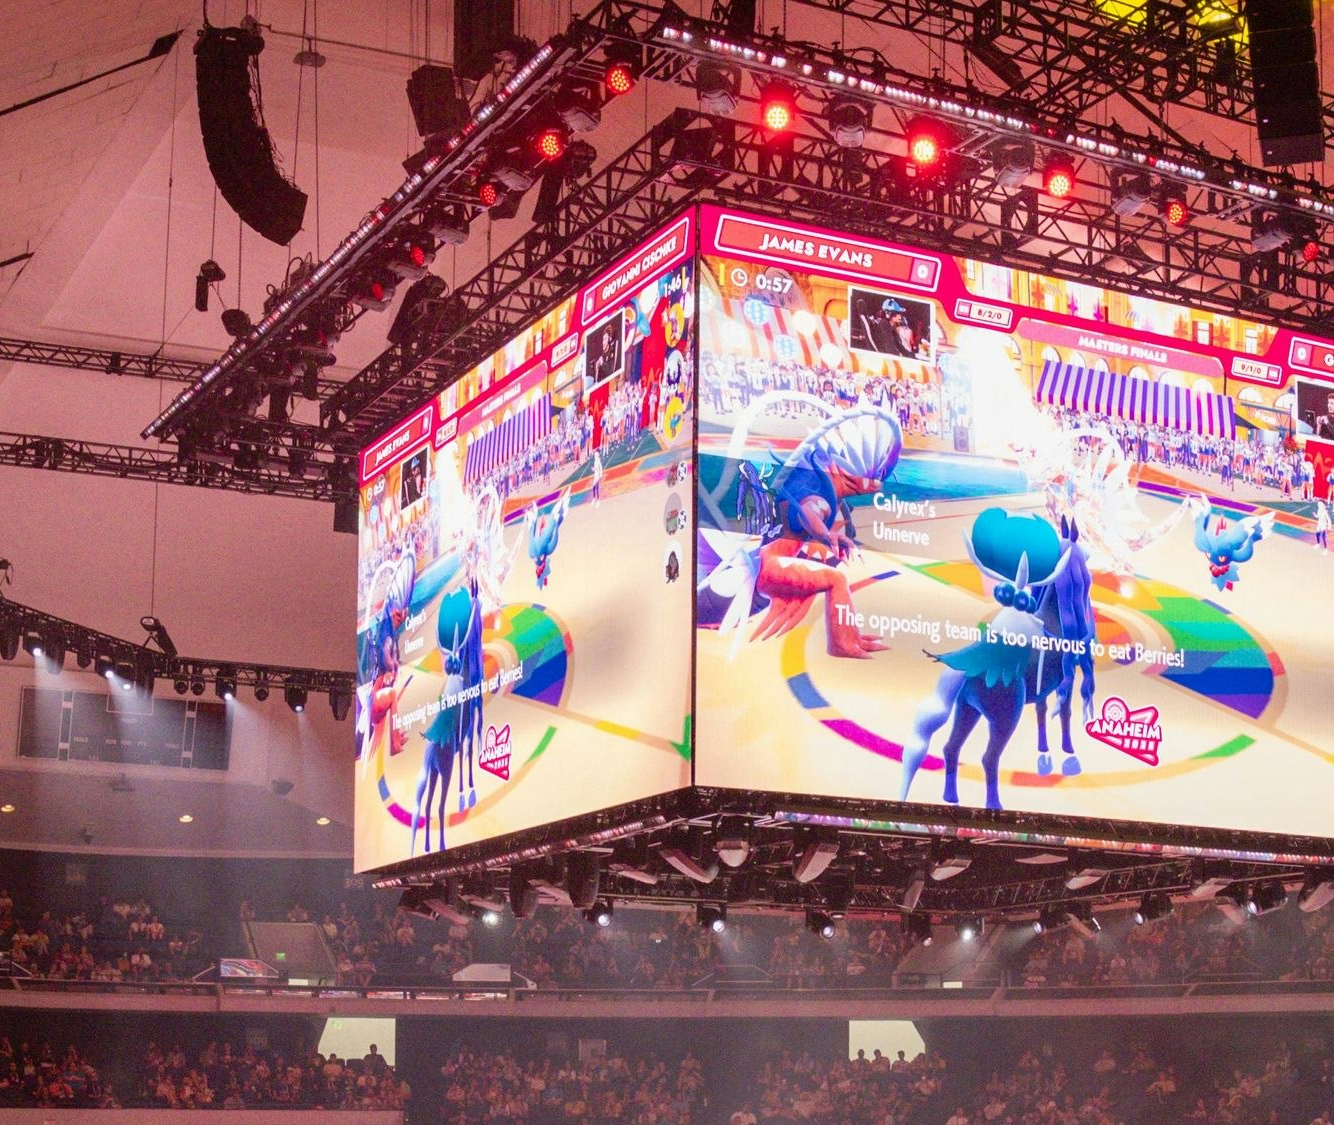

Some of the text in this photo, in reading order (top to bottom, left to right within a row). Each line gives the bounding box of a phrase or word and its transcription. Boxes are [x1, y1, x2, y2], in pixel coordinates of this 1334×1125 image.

[758, 233, 873, 268] JAMES EVANS
[602, 262, 641, 300] GIOVANNI
[755, 273, 793, 294] 0:57
[917, 264, 928, 279] 0
[663, 274, 681, 298] 1:46
[977, 308, 1002, 320] 8/2/0
[1078, 336, 1168, 363] MASTERS FINALS
[1240, 363, 1262, 375] 9/1/0
[873, 491, 936, 520] Calyrex's
[873, 521, 930, 547] Unnerve
[835, 604, 1185, 668] The opposing team is too nervous to eat Berries!
[1090, 719, 1161, 740] ANAHEIM
